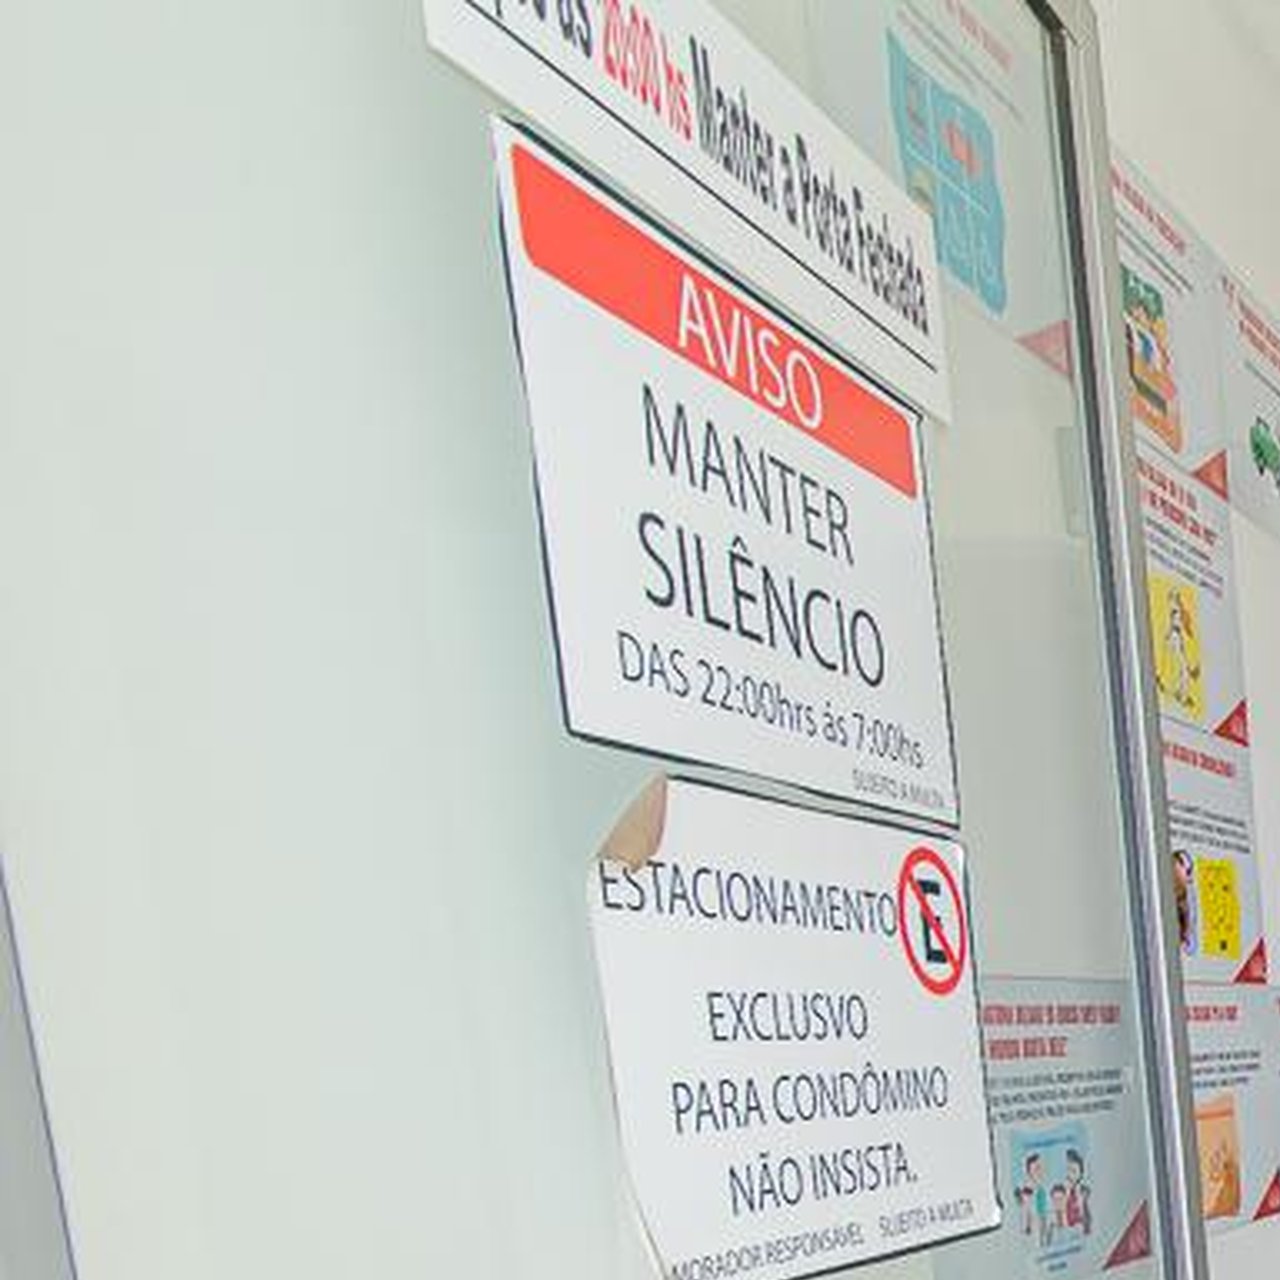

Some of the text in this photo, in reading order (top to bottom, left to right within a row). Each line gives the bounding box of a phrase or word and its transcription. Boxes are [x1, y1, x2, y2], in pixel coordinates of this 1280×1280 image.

[689, 33, 777, 211] Manter
[795, 132, 854, 275] Porta
[853, 184, 930, 336] Fechada
[678, 272, 823, 429] AVISO
[643, 382, 855, 567] MANTER
[638, 512, 884, 688] SILÊNCIO
[617, 630, 691, 699] DAS
[697, 658, 818, 738] 22:00hrs
[599, 855, 899, 938] ESTACIONAMENTO
[706, 991, 870, 1042] EXCLUSVO
[671, 1077, 766, 1134] PARA
[772, 1062, 948, 1126] CONDÔMINO
[729, 1143, 918, 1217] NÃO INSISTA.
